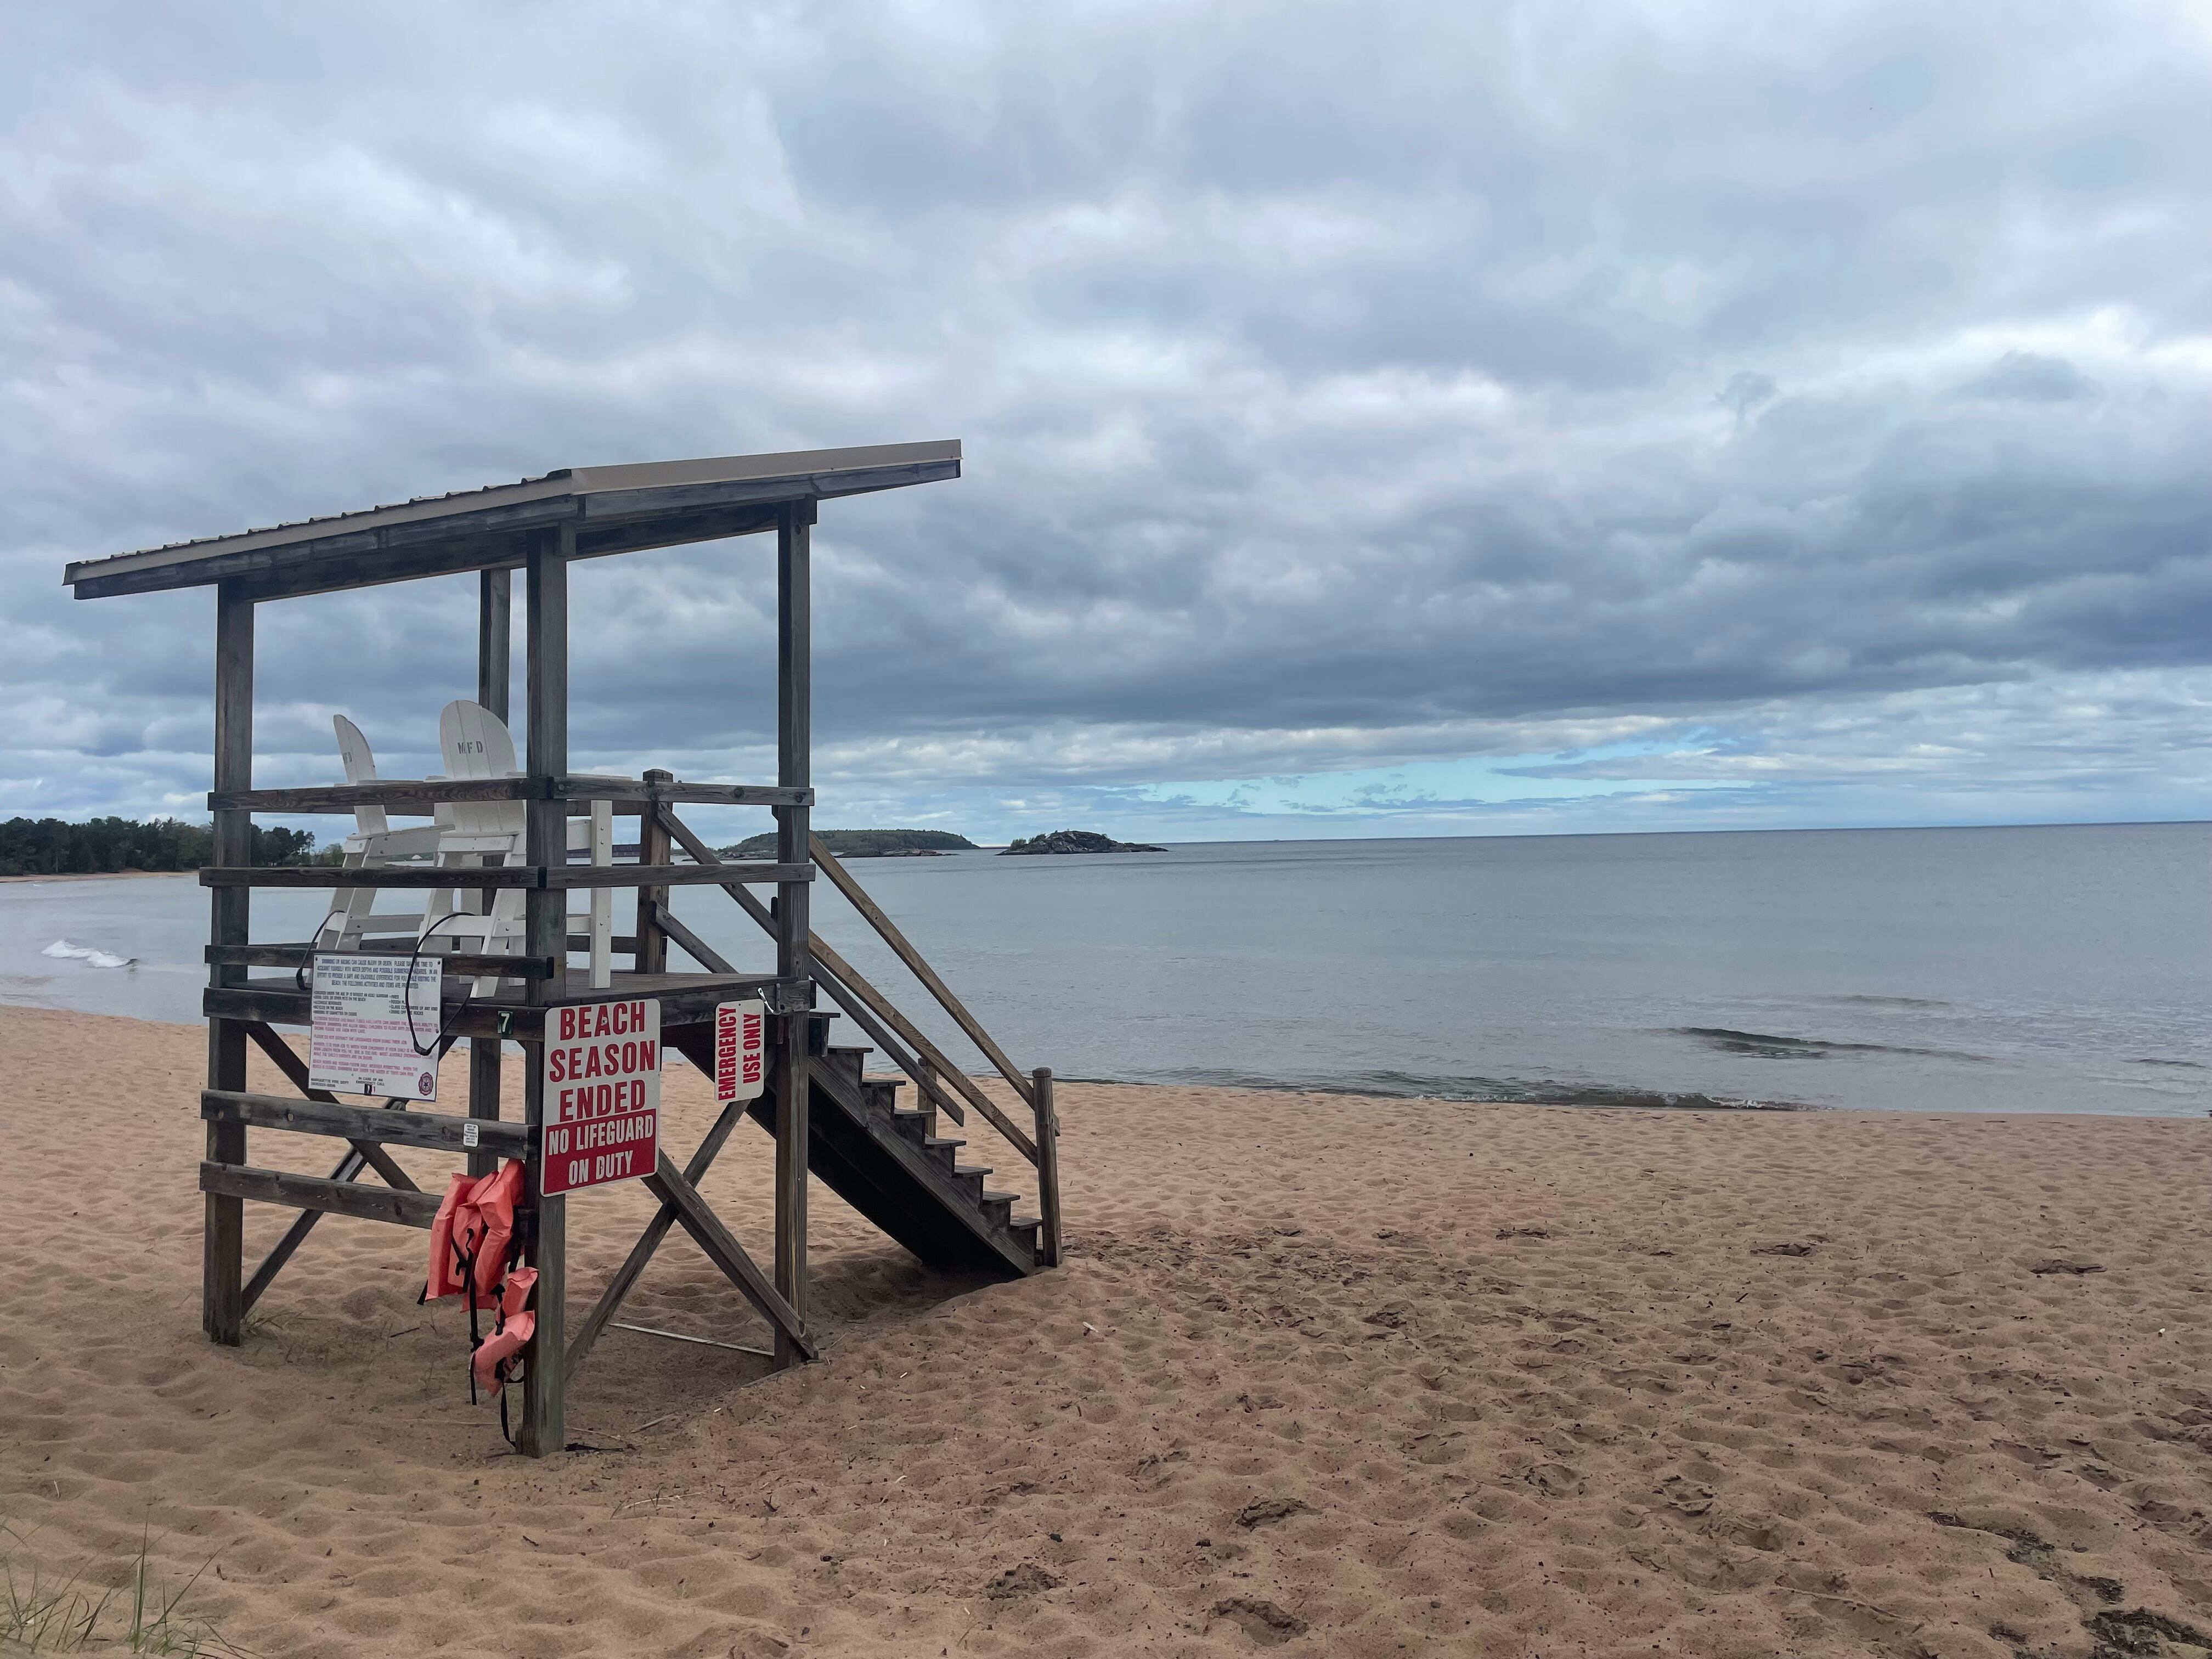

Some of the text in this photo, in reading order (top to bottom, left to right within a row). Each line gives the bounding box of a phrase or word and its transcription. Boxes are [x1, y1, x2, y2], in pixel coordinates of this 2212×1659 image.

[501, 1013, 510, 1032] 7
[560, 1002, 646, 1041] BEACH
[549, 1040, 656, 1082] SEASON
[718, 1007, 737, 1101] EMERGENCY
[742, 1013, 761, 1084] USE ONLY
[560, 1079, 646, 1122] ENDED
[549, 1114, 653, 1156] NO LIFEGUARD
[568, 1150, 634, 1185] ON DUTY
